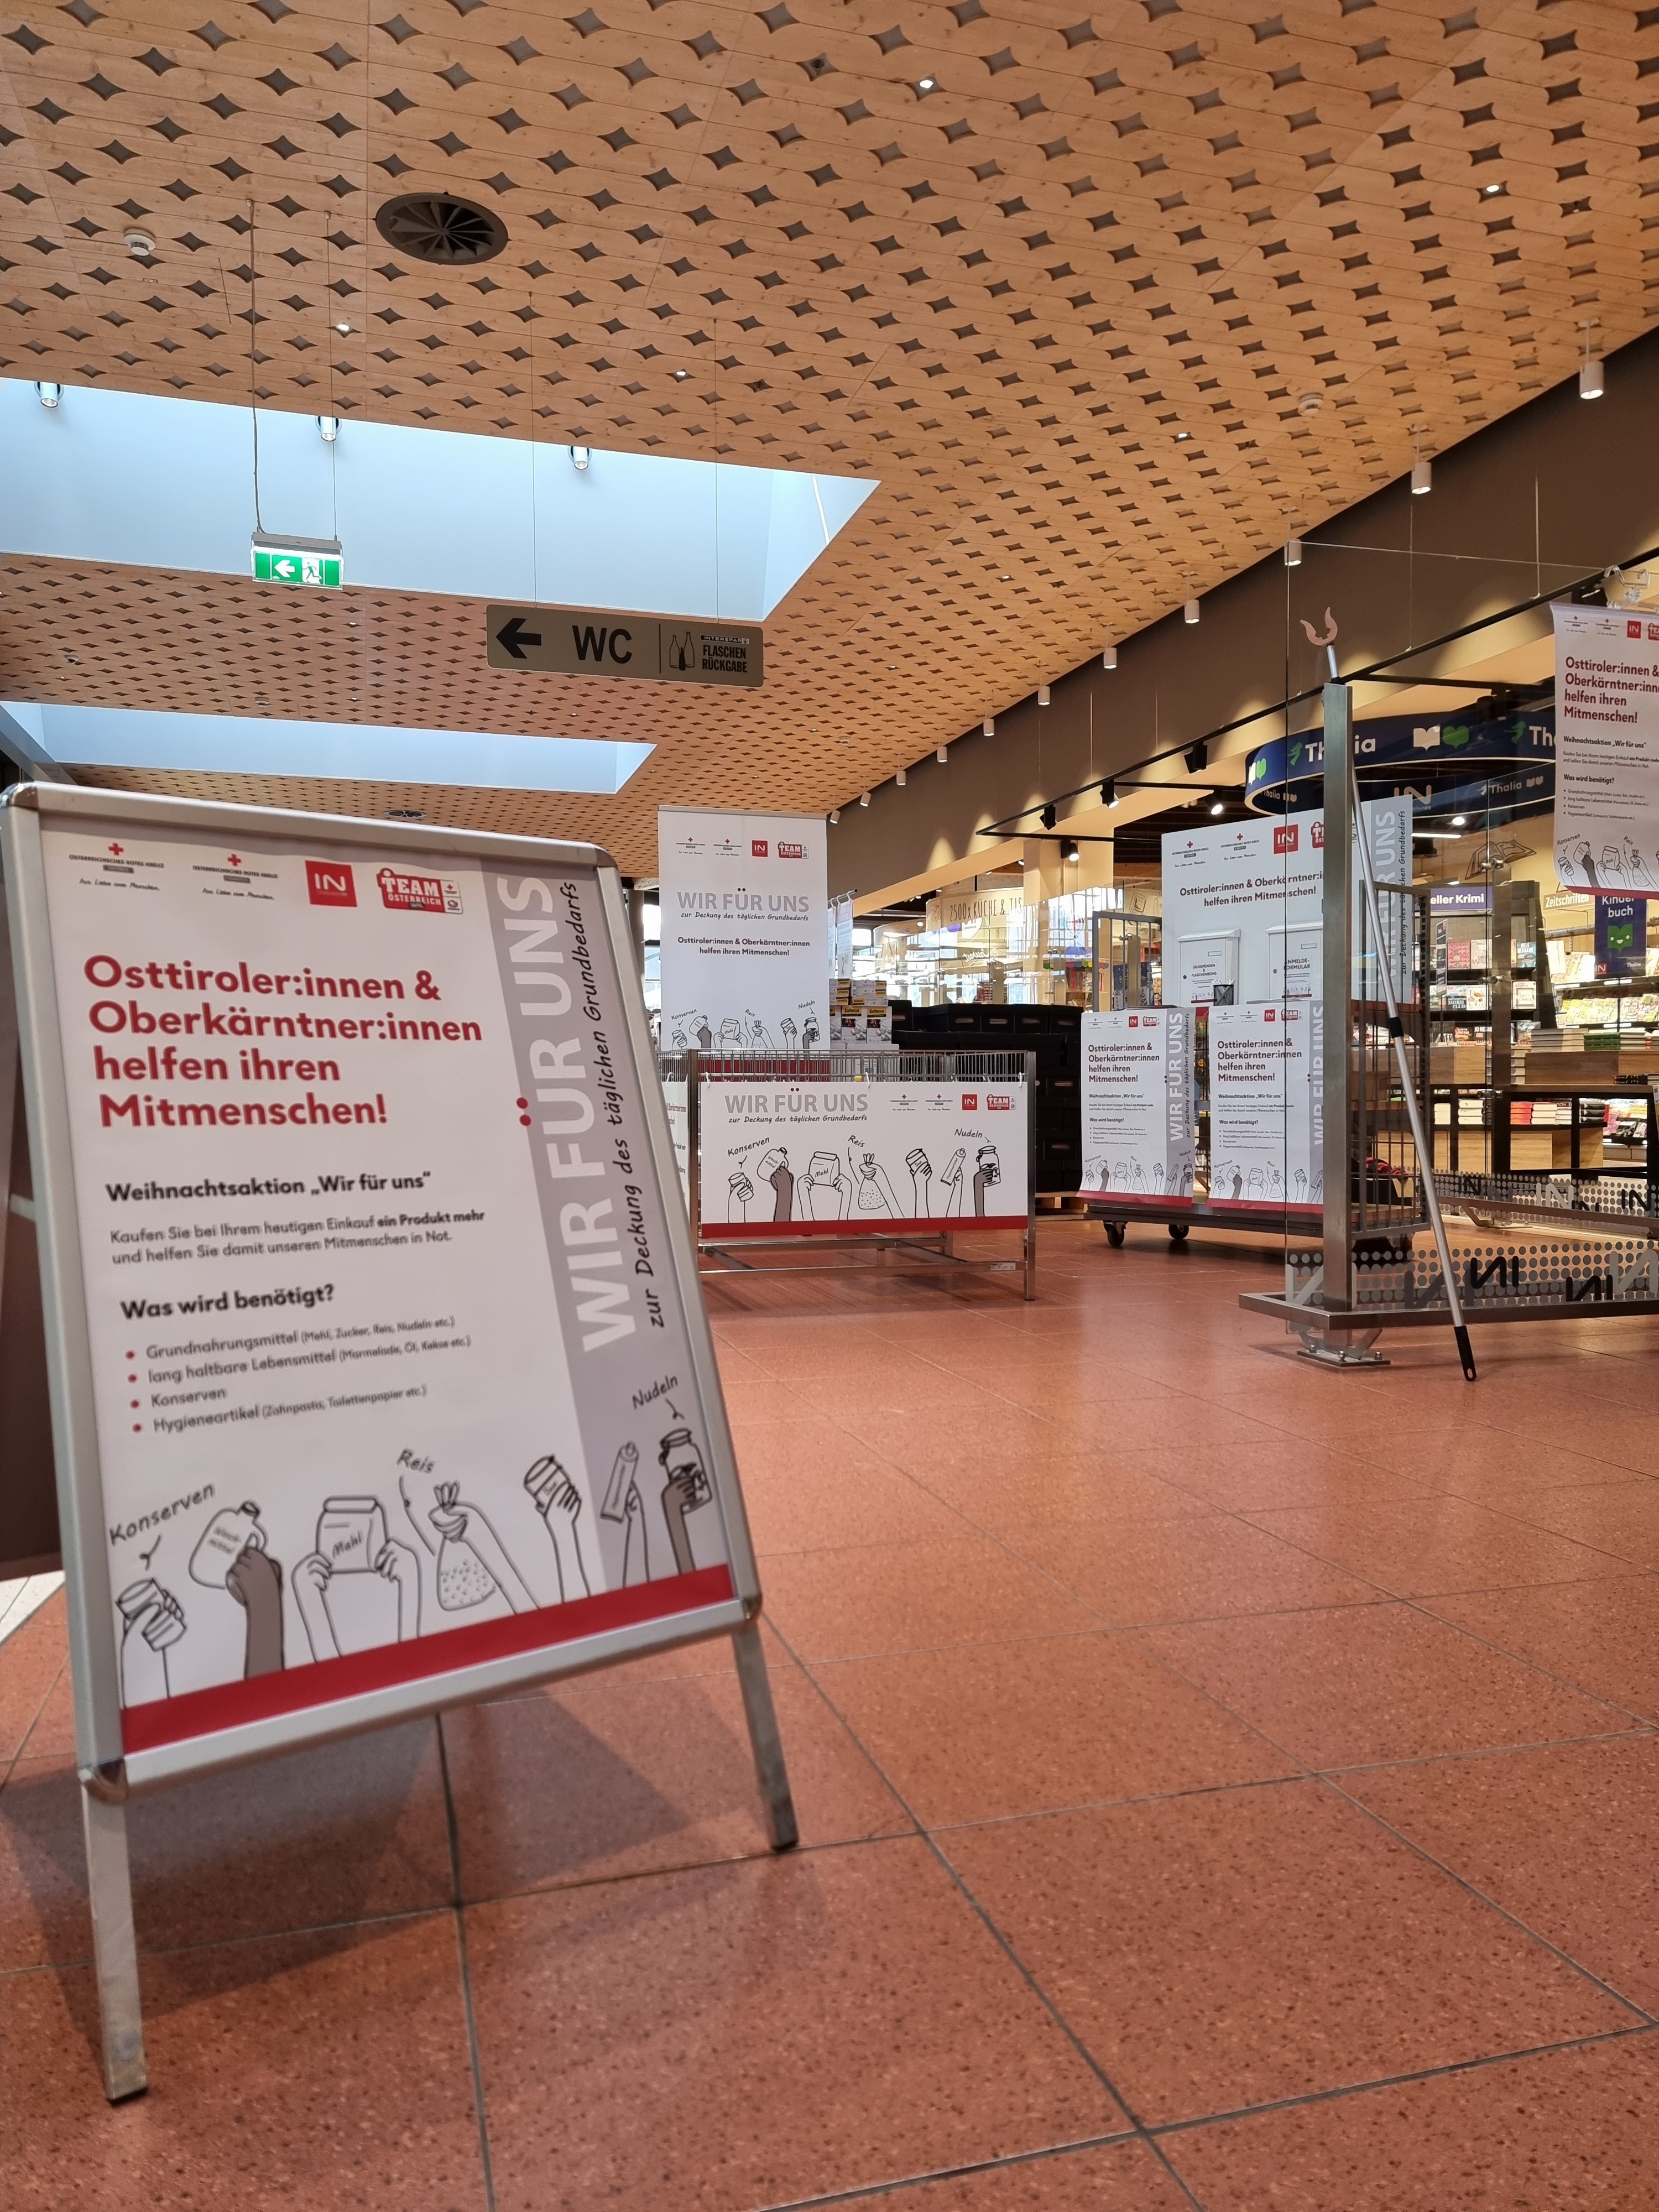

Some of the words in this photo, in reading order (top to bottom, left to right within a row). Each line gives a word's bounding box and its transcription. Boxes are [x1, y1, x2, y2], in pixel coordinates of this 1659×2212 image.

[572, 625, 632, 664] WC
[703, 635, 742, 644] INTERSPAR
[703, 645, 746, 659] FLASCHEN
[702, 656, 748, 673] RÜCKGABE
[1565, 656, 1650, 677] Osttiroler:innen
[1652, 665, 1659, 677] &
[1564, 688, 1597, 706] helfen
[1599, 693, 1626, 707] ihren
[1564, 705, 1637, 723] Mitmenschen!
[1305, 734, 1376, 763] Thia
[1491, 780, 1522, 794] Thalia
[1589, 776, 1614, 785] benötigt?
[1375, 811, 1396, 867] UNS
[315, 873, 346, 891] IN
[381, 877, 440, 896] TEAM
[1180, 881, 1244, 896] Osttiroler:innen
[388, 894, 441, 905] ÖSTERREICH
[677, 891, 717, 909] WIR
[723, 888, 763, 911] FÜR
[768, 895, 809, 912] UNS
[1204, 895, 1229, 906] helfen
[1232, 893, 1252, 904] ihren
[1255, 885, 1316, 901] Mitmenschen!
[1431, 894, 1453, 905] eller
[1455, 893, 1484, 904] Krimi
[1545, 894, 1589, 908] Zeitschriften
[695, 911, 721, 920] Deckung
[974, 899, 997, 917] KÜCHE
[1001, 899, 1005, 915] &
[1608, 905, 1633, 917] buch
[497, 876, 572, 1017] UNS
[559, 880, 603, 1021] Grundbedarfs
[678, 937, 733, 945] Osttiroler:innen
[742, 938, 810, 947] Oberkärntner:innen
[84, 954, 405, 999] Osttiroler:innen
[415, 969, 442, 1000] &
[671, 1009, 697, 1020] Konserven
[744, 1009, 756, 1018] Reis
[798, 1000, 815, 1009] Nudeln
[89, 1000, 482, 1040] Oberkärntner:innen
[1169, 1013, 1183, 1053] UNS
[1218, 1040, 1284, 1048] Osttiroler:innen
[1286, 1038, 1293, 1046] &
[1088, 1044, 1145, 1052] Osttiroler:innen
[1147, 1042, 1152, 1051] &
[1218, 1050, 1302, 1060] Oberkärntner:innen
[93, 1045, 228, 1080] helfen
[239, 1048, 341, 1082] ihren
[1088, 1054, 1160, 1062] Oberkärntner:innen
[1218, 1062, 1243, 1071] helfen
[594, 1030, 625, 1127] täglichen
[1218, 1073, 1275, 1082] Mitmenschen!
[99, 1092, 388, 1127] Mitmenschen!
[725, 1095, 768, 1113] WIR
[775, 1088, 817, 1113] FÜR
[823, 1094, 868, 1112] UNS
[790, 1115, 820, 1123] täglichen
[1170, 1103, 1183, 1141] WIR
[848, 1135, 865, 1147] Reis
[954, 1128, 983, 1138] Nudeln
[613, 1137, 633, 1175] des
[728, 1137, 770, 1156] Konserven
[815, 1167, 829, 1177] Mehl
[106, 1177, 305, 1202] Weihnachtsaktion
[358, 1173, 387, 1192] für
[111, 1227, 164, 1244] Kaufen
[168, 1226, 191, 1240] Sie
[194, 1224, 216, 1239] bei
[220, 1222, 260, 1237] Ihrem
[263, 1219, 324, 1237] heutigen
[326, 1215, 375, 1231] Einkauf
[377, 1215, 397, 1227] ein
[399, 1211, 452, 1227] Produkt
[453, 1209, 486, 1223] mehr
[623, 1185, 654, 1278] Deckung
[112, 1250, 142, 1265] und
[145, 1247, 192, 1262] helfen
[196, 1245, 218, 1259] Sie
[222, 1242, 264, 1257] damit
[267, 1240, 321, 1254] unseren
[324, 1233, 408, 1250] Mitmenschen
[411, 1232, 423, 1244] in
[560, 1197, 636, 1353] WIR
[120, 1299, 173, 1319] Was
[178, 1291, 229, 1313] wird
[234, 1282, 335, 1309] benötigt?
[650, 1290, 665, 1328] zur
[146, 1332, 298, 1360] Grundnahrungsmittel
[397, 1318, 431, 1333] Nudeln
[148, 1368, 183, 1385] lang
[186, 1360, 248, 1379] haltbare
[252, 1350, 336, 1372] Lebensmittel
[150, 1387, 227, 1408] Konserven
[632, 1375, 679, 1410] Nudeln
[153, 1405, 259, 1434] Hygieneartikel
[397, 1448, 435, 1474] Reis
[109, 1483, 215, 1545] Konserven
